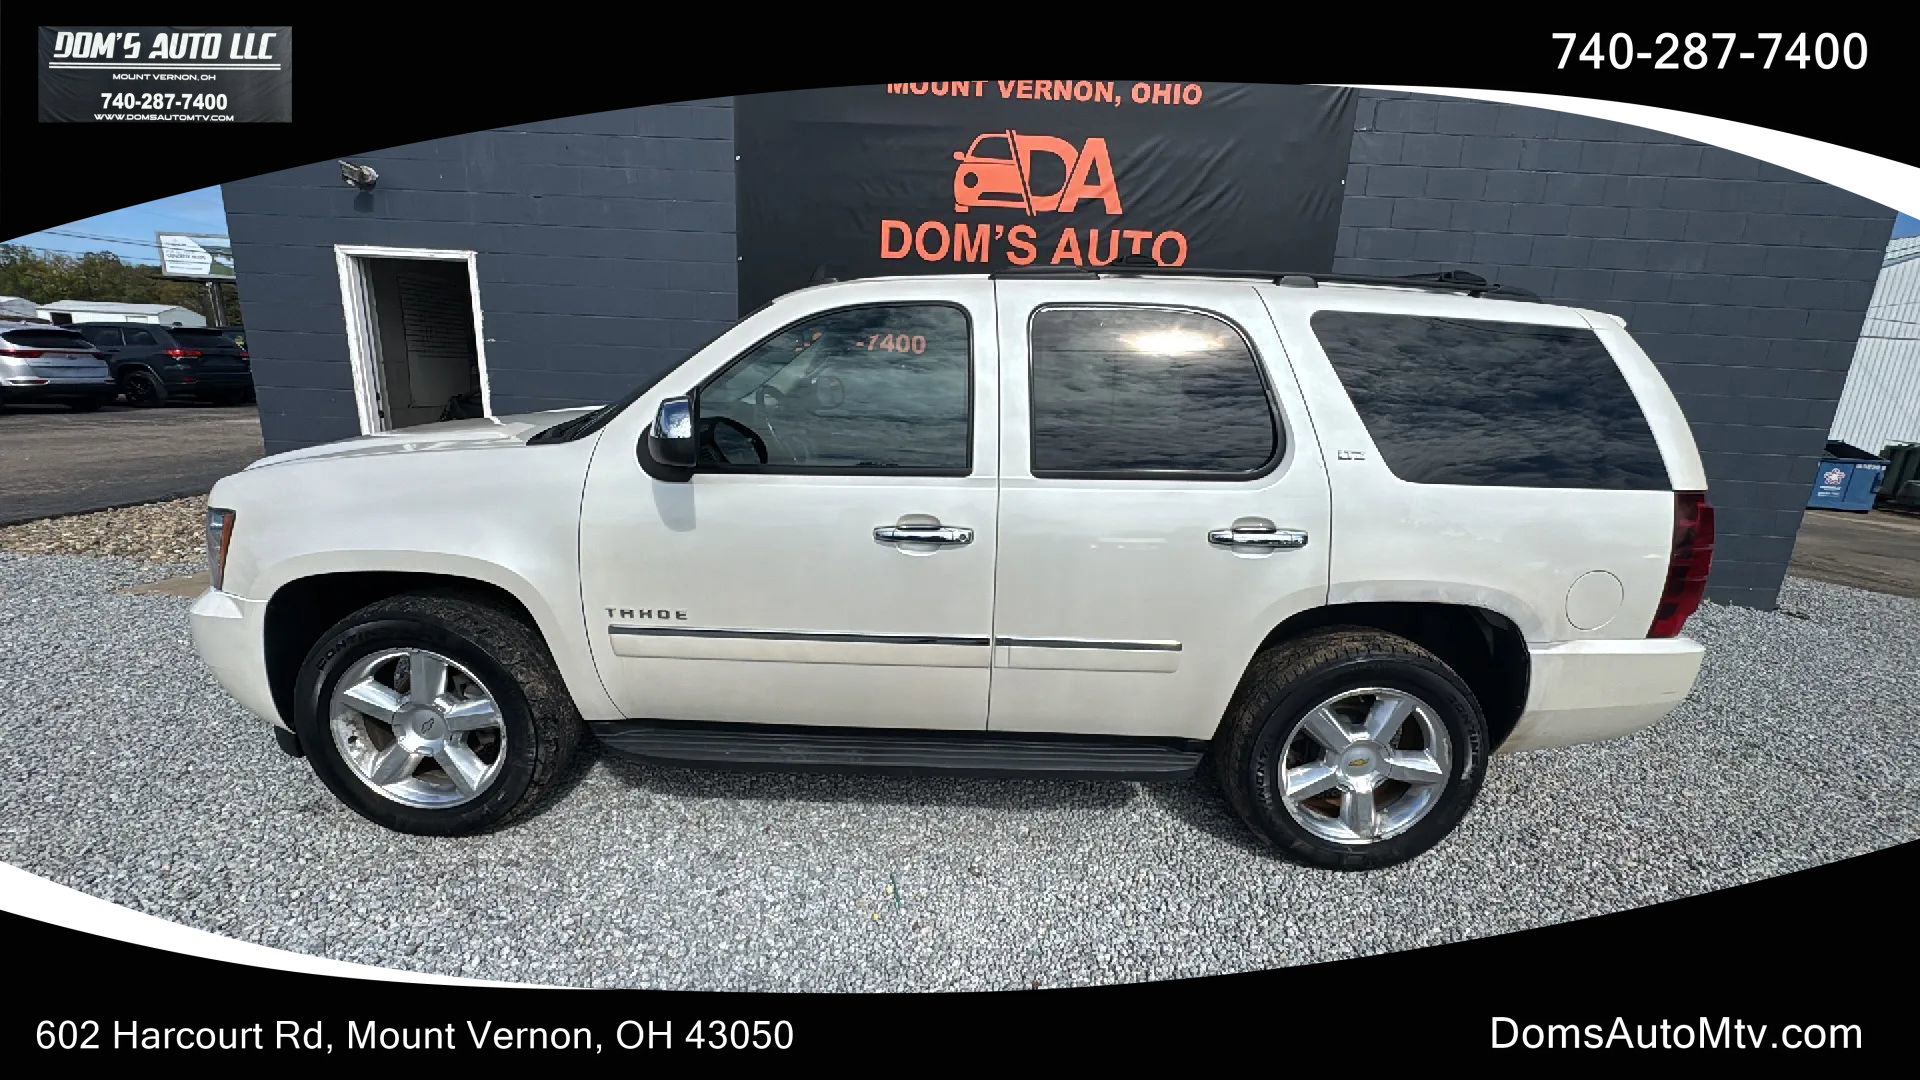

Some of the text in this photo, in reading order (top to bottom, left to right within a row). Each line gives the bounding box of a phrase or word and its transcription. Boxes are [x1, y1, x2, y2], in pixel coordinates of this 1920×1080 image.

[887, 80, 1203, 107] MOUNT VERNON, OHIO
[880, 219, 1189, 267] DOM'S AUTO
[604, 607, 688, 621] TAHOE
